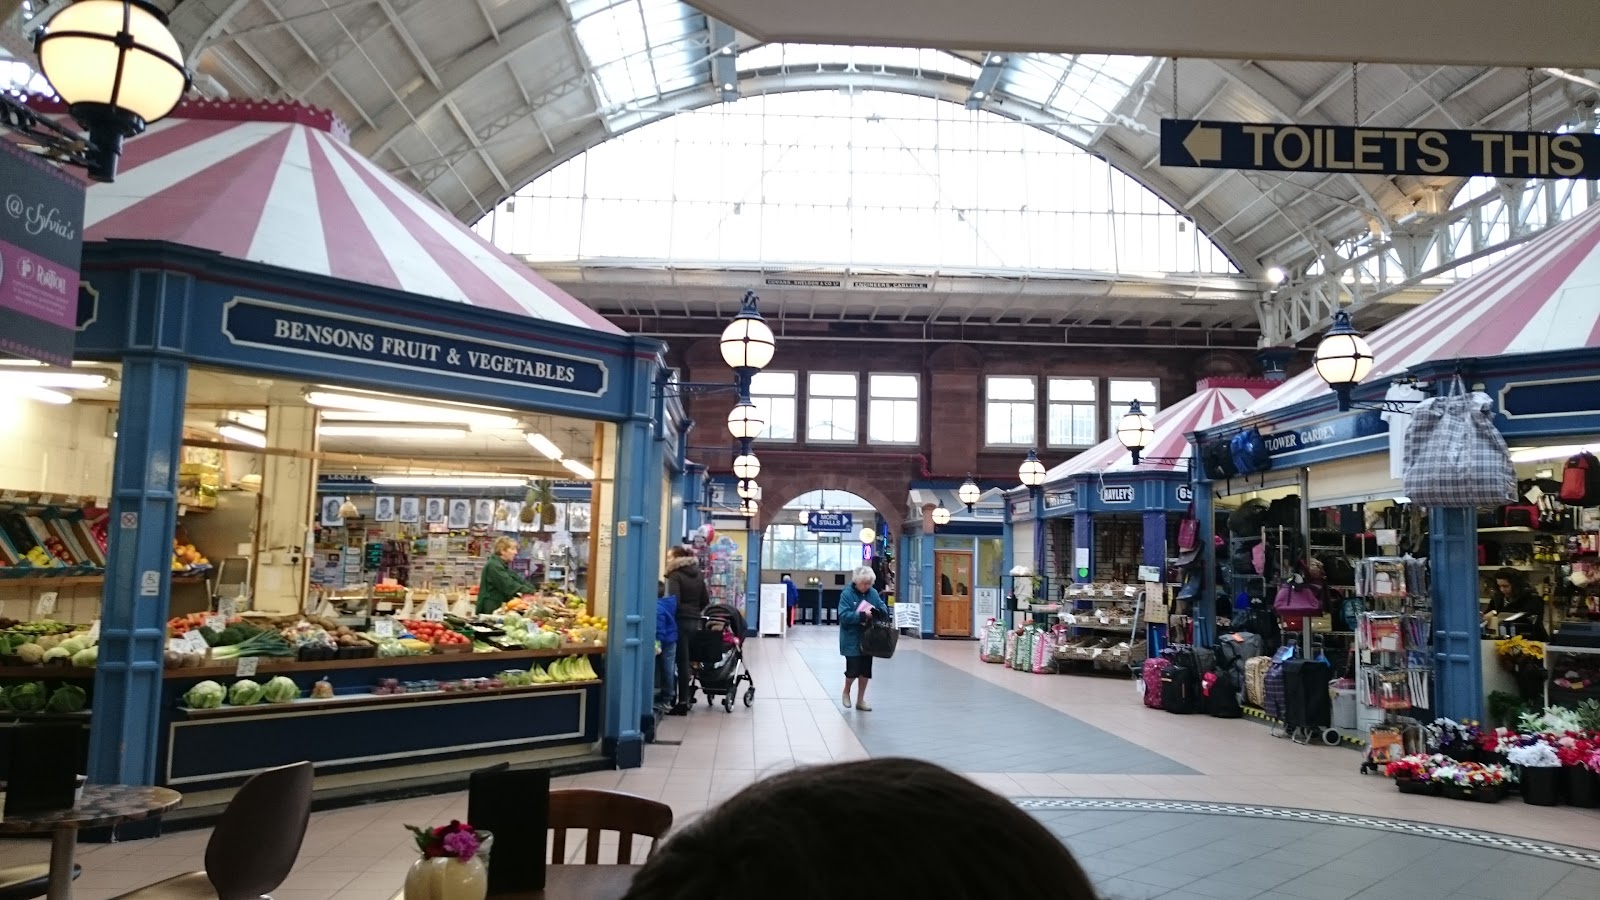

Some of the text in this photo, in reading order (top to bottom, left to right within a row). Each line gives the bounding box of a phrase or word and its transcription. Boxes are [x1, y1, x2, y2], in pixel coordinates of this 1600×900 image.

[1242, 125, 1584, 177] TOILETS THIS
[6, 194, 75, 240] @ Sylvia's
[274, 318, 575, 384] BENSONS FRUIT & VEGETABLES
[1300, 424, 1336, 445] GARDEN
